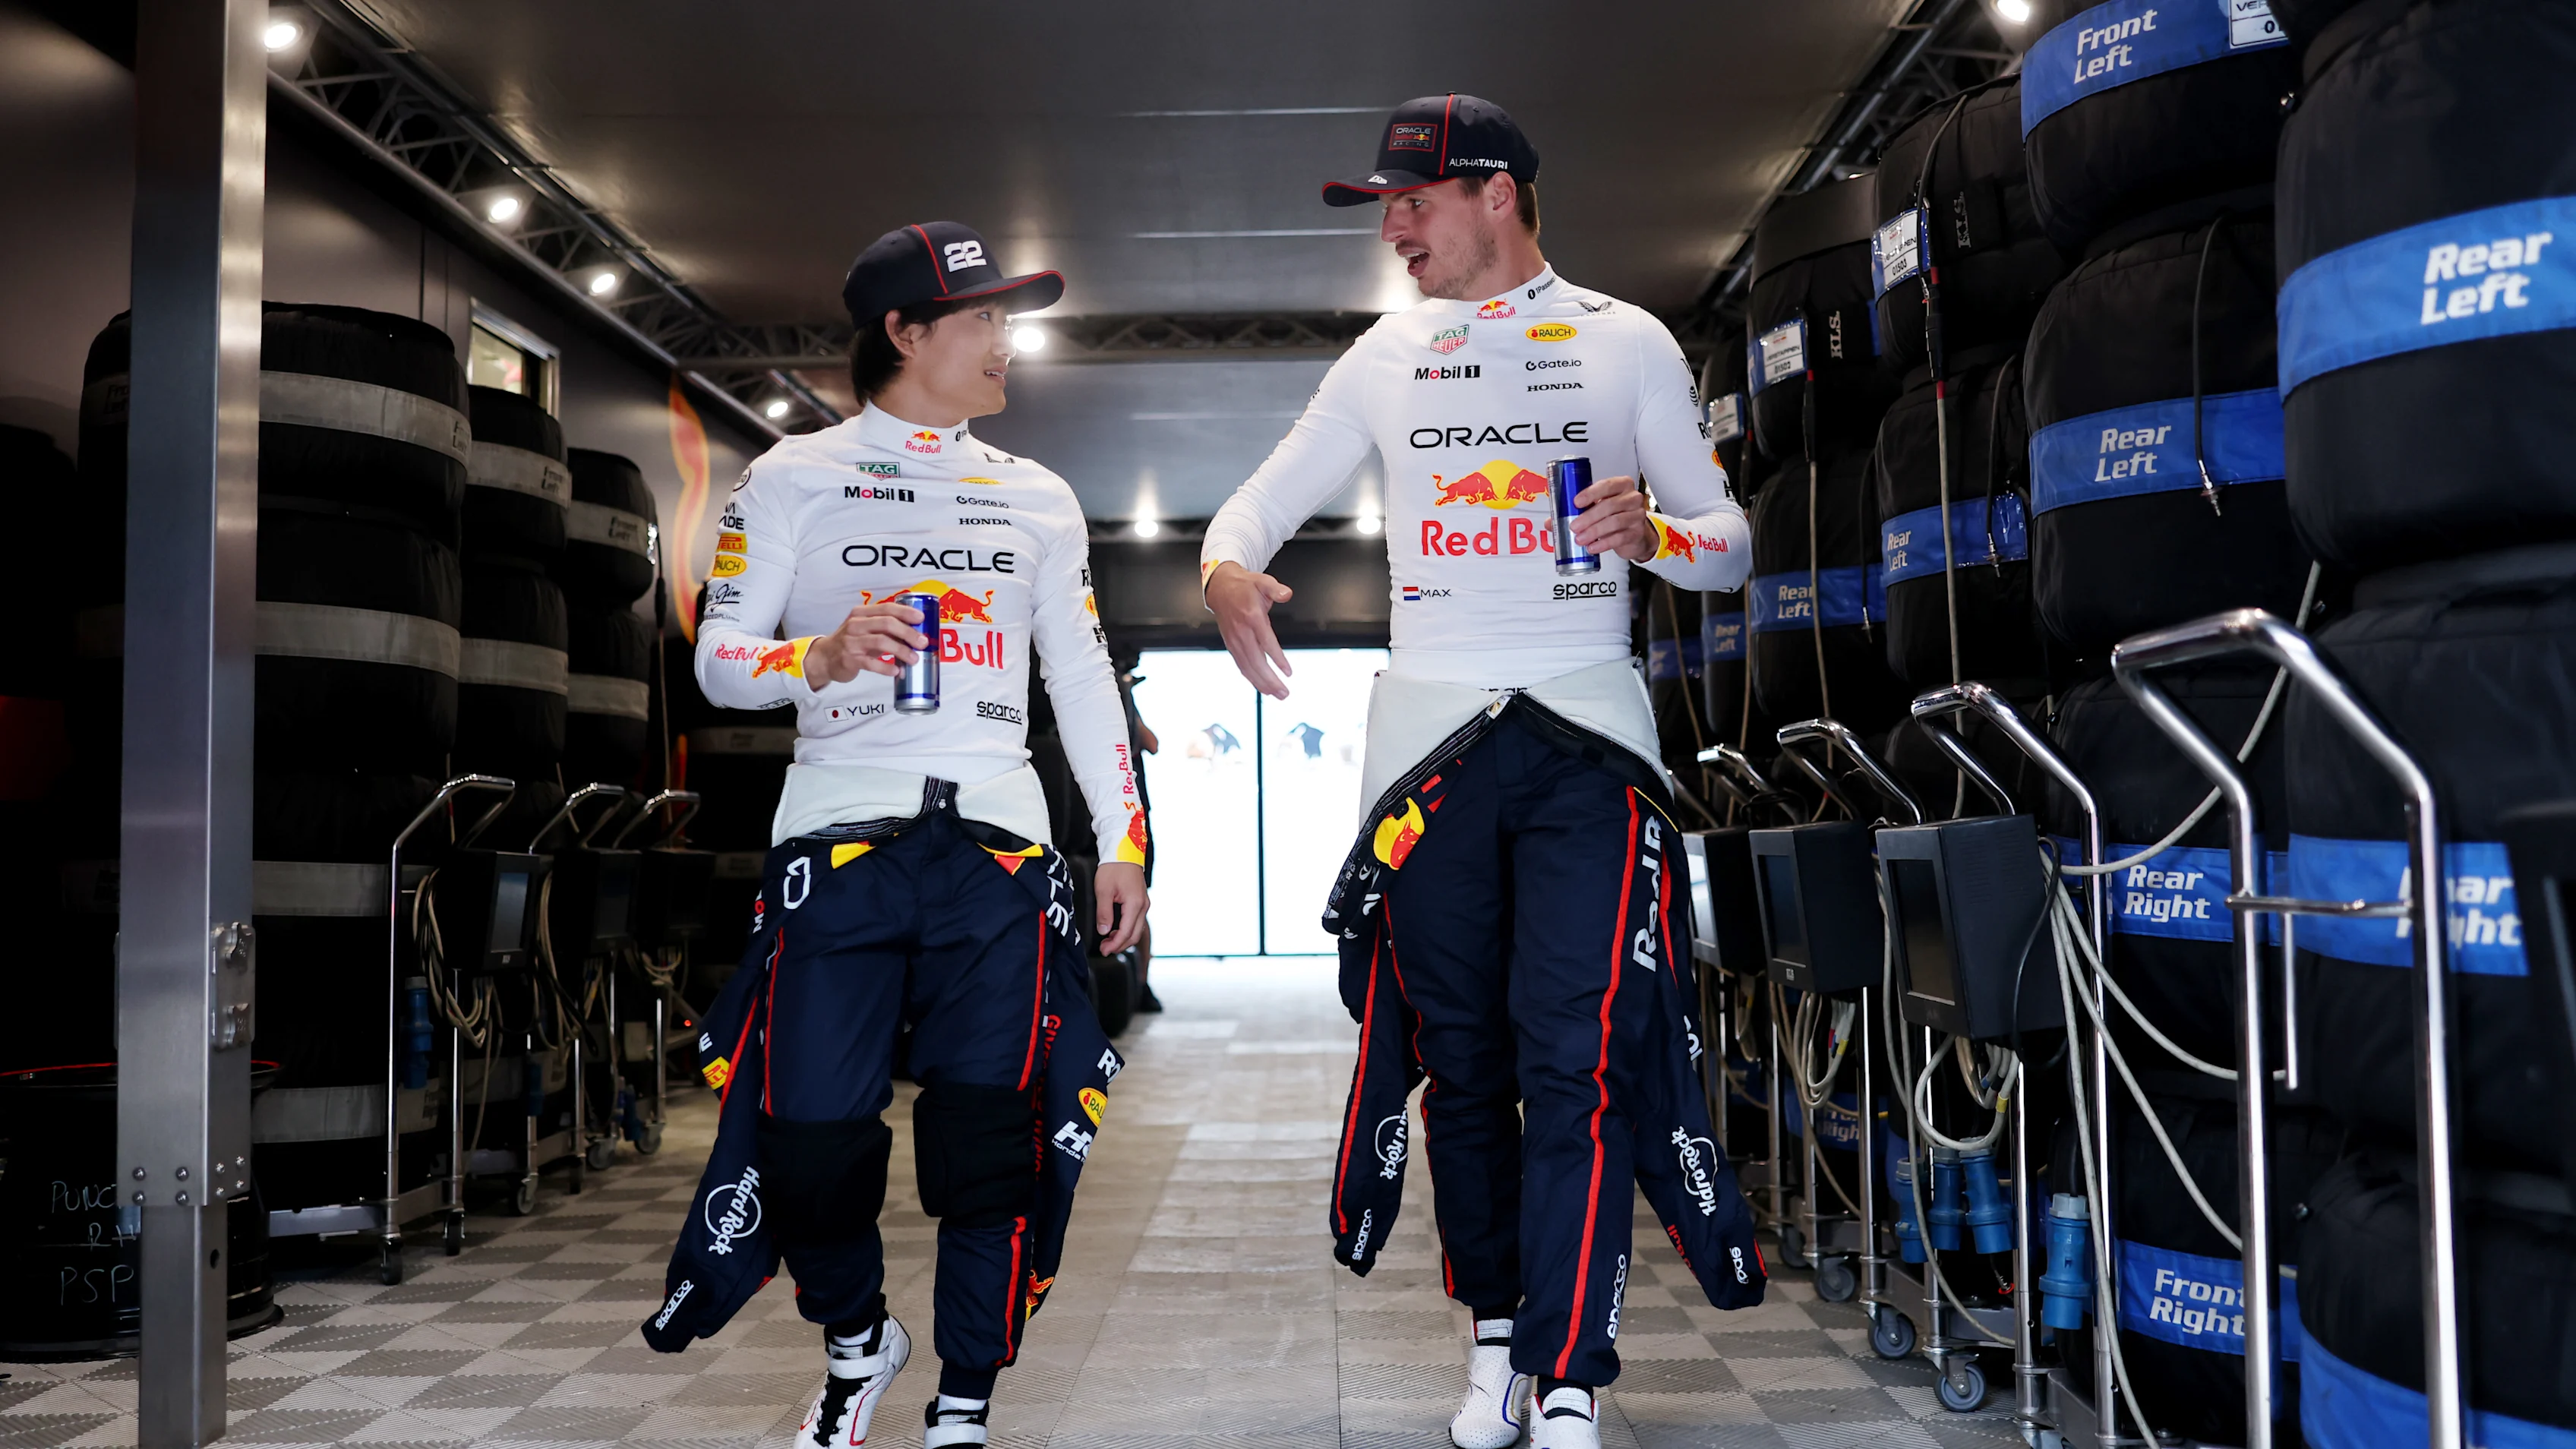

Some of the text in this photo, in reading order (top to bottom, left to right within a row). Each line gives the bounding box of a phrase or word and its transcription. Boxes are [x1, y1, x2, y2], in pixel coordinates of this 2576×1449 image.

[2077, 8, 2158, 56] Front
[2074, 44, 2132, 84] Left
[1449, 158, 1507, 169] ALPHATAURI
[944, 240, 987, 273] 22
[2423, 232, 2552, 285] Rear
[2420, 272, 2529, 327] Left
[1435, 327, 1466, 341] TAG
[1539, 328, 1571, 337] RAUCH
[1432, 336, 1466, 353] HEUER
[1414, 366, 1461, 380] Mobil
[1538, 359, 1582, 370] Gate.io
[1526, 382, 1584, 392] HONDA
[1410, 421, 1589, 449] ORACLE
[2100, 424, 2172, 454] Rear
[904, 440, 942, 454] Red Bull
[860, 464, 896, 475] TAG
[2095, 453, 2158, 483] Left
[844, 486, 895, 500] Mobil
[968, 497, 1009, 509] Gate.io
[718, 515, 744, 530] ADE
[958, 518, 1012, 526] HONDA
[1421, 517, 1555, 557] Red Bu
[1887, 530, 1911, 552] Rear
[716, 560, 741, 572] AUCH
[842, 545, 1015, 573] ORACLE
[1888, 551, 1908, 572] Left
[1420, 589, 1452, 598] MAX
[1553, 580, 1617, 601] sparco
[1777, 601, 1812, 619] Left
[939, 628, 1004, 671] Bull
[847, 704, 885, 717] YUKI
[977, 700, 1022, 724] sparco
[1115, 744, 1129, 771] Bull
[2126, 863, 2203, 892] Rear
[2123, 892, 2211, 927] Right
[1088, 1097, 1103, 1119] RAU
[1823, 1121, 1860, 1142] Righ
[1672, 1125, 1717, 1217] Hard Rock
[52, 1181, 118, 1213] PUNC
[708, 1165, 760, 1255] Hard Rock
[1352, 1208, 1372, 1261] sparco
[61, 1264, 134, 1305] PSP
[655, 1279, 694, 1331] sparco
[1606, 1254, 1626, 1340] sparco
